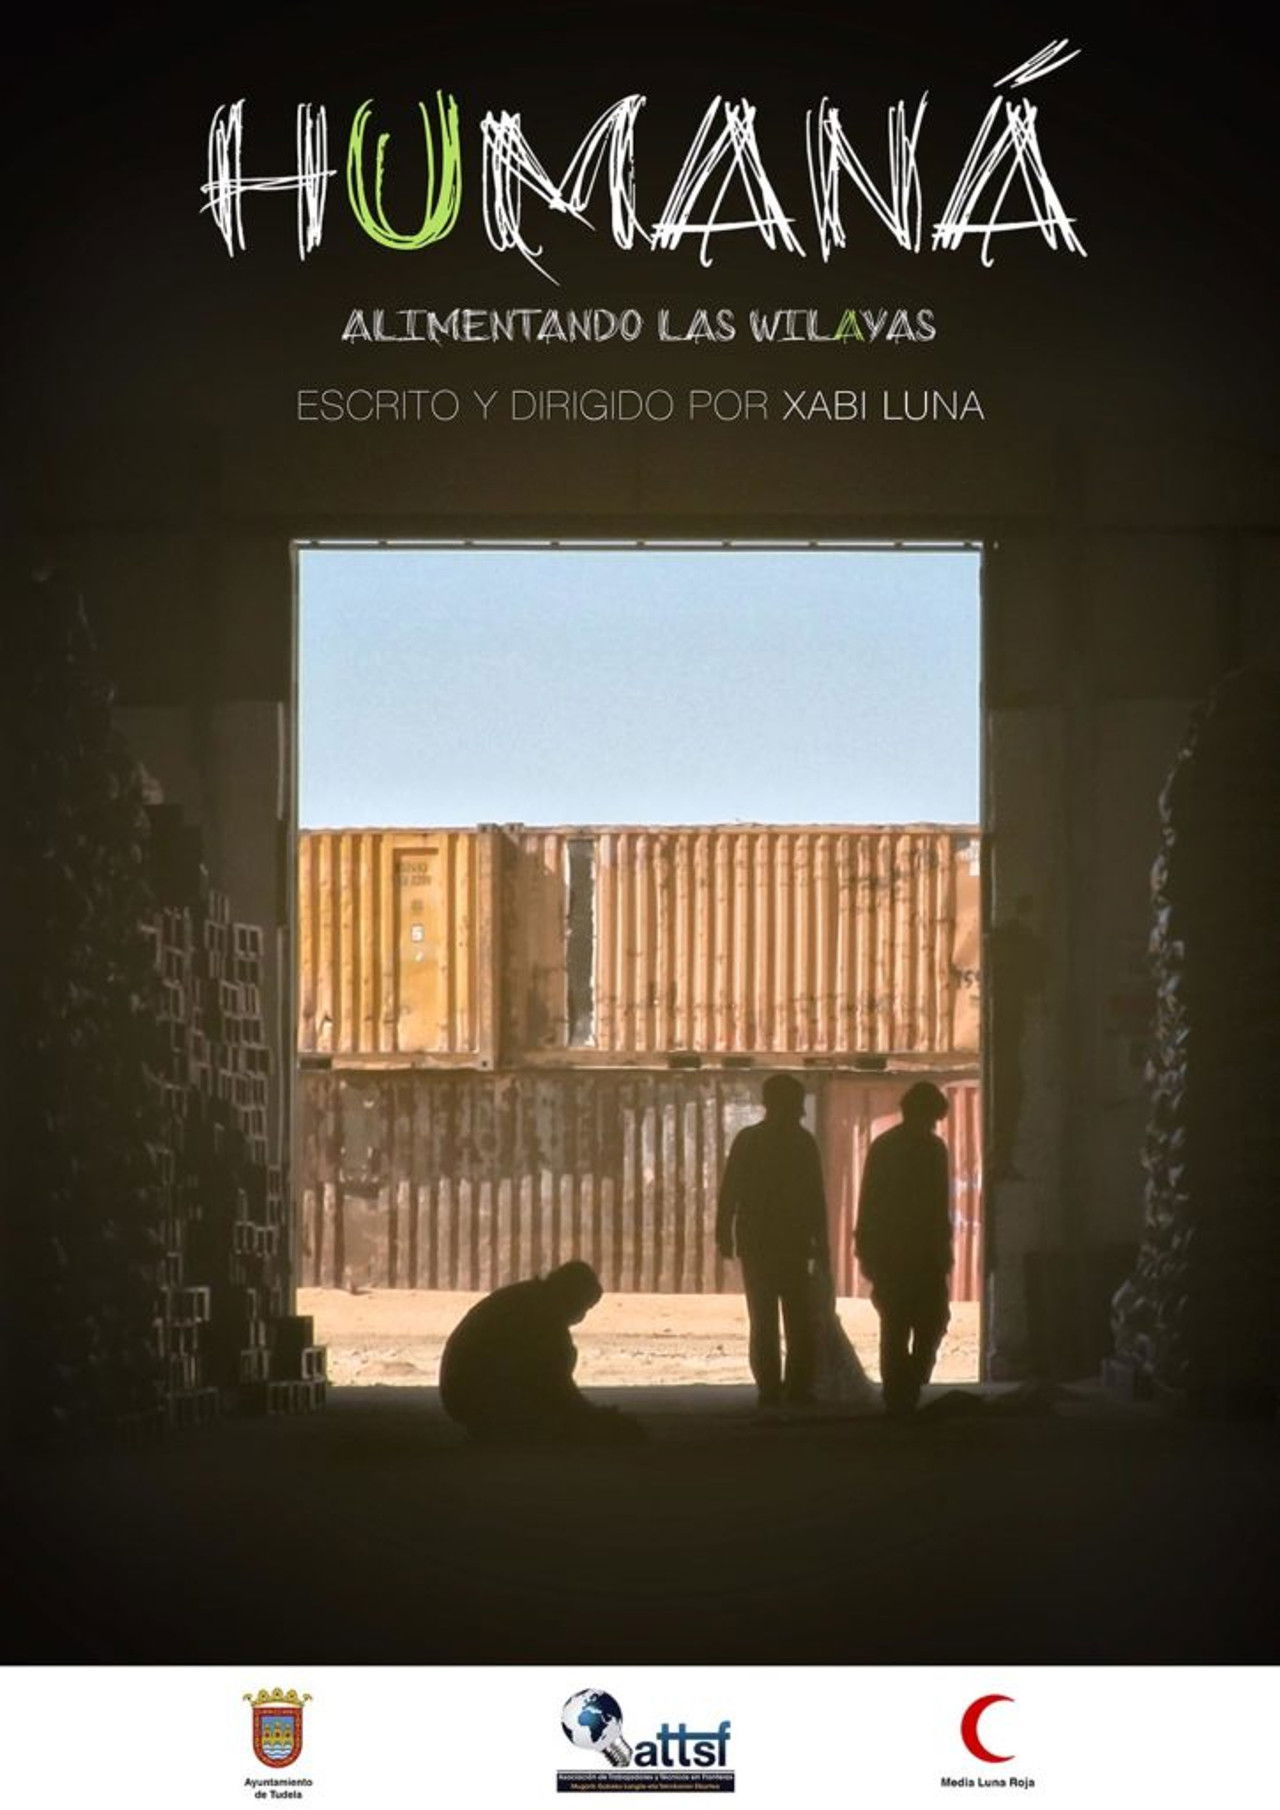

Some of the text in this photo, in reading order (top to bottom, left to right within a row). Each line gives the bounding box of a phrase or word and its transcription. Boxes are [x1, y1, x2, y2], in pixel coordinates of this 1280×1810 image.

[200, 39, 1087, 285] HUMANÁ
[341, 308, 936, 345] ALIMENTANDO LAS WILAYAS
[297, 389, 985, 421] ESCRITO Y DIRIGIDO POR XABI LUNA
[244, 1778, 313, 1788] Ayuntamiento
[254, 1789, 303, 1799] de Tudela
[940, 1777, 1036, 1790] Media Luna Roja
